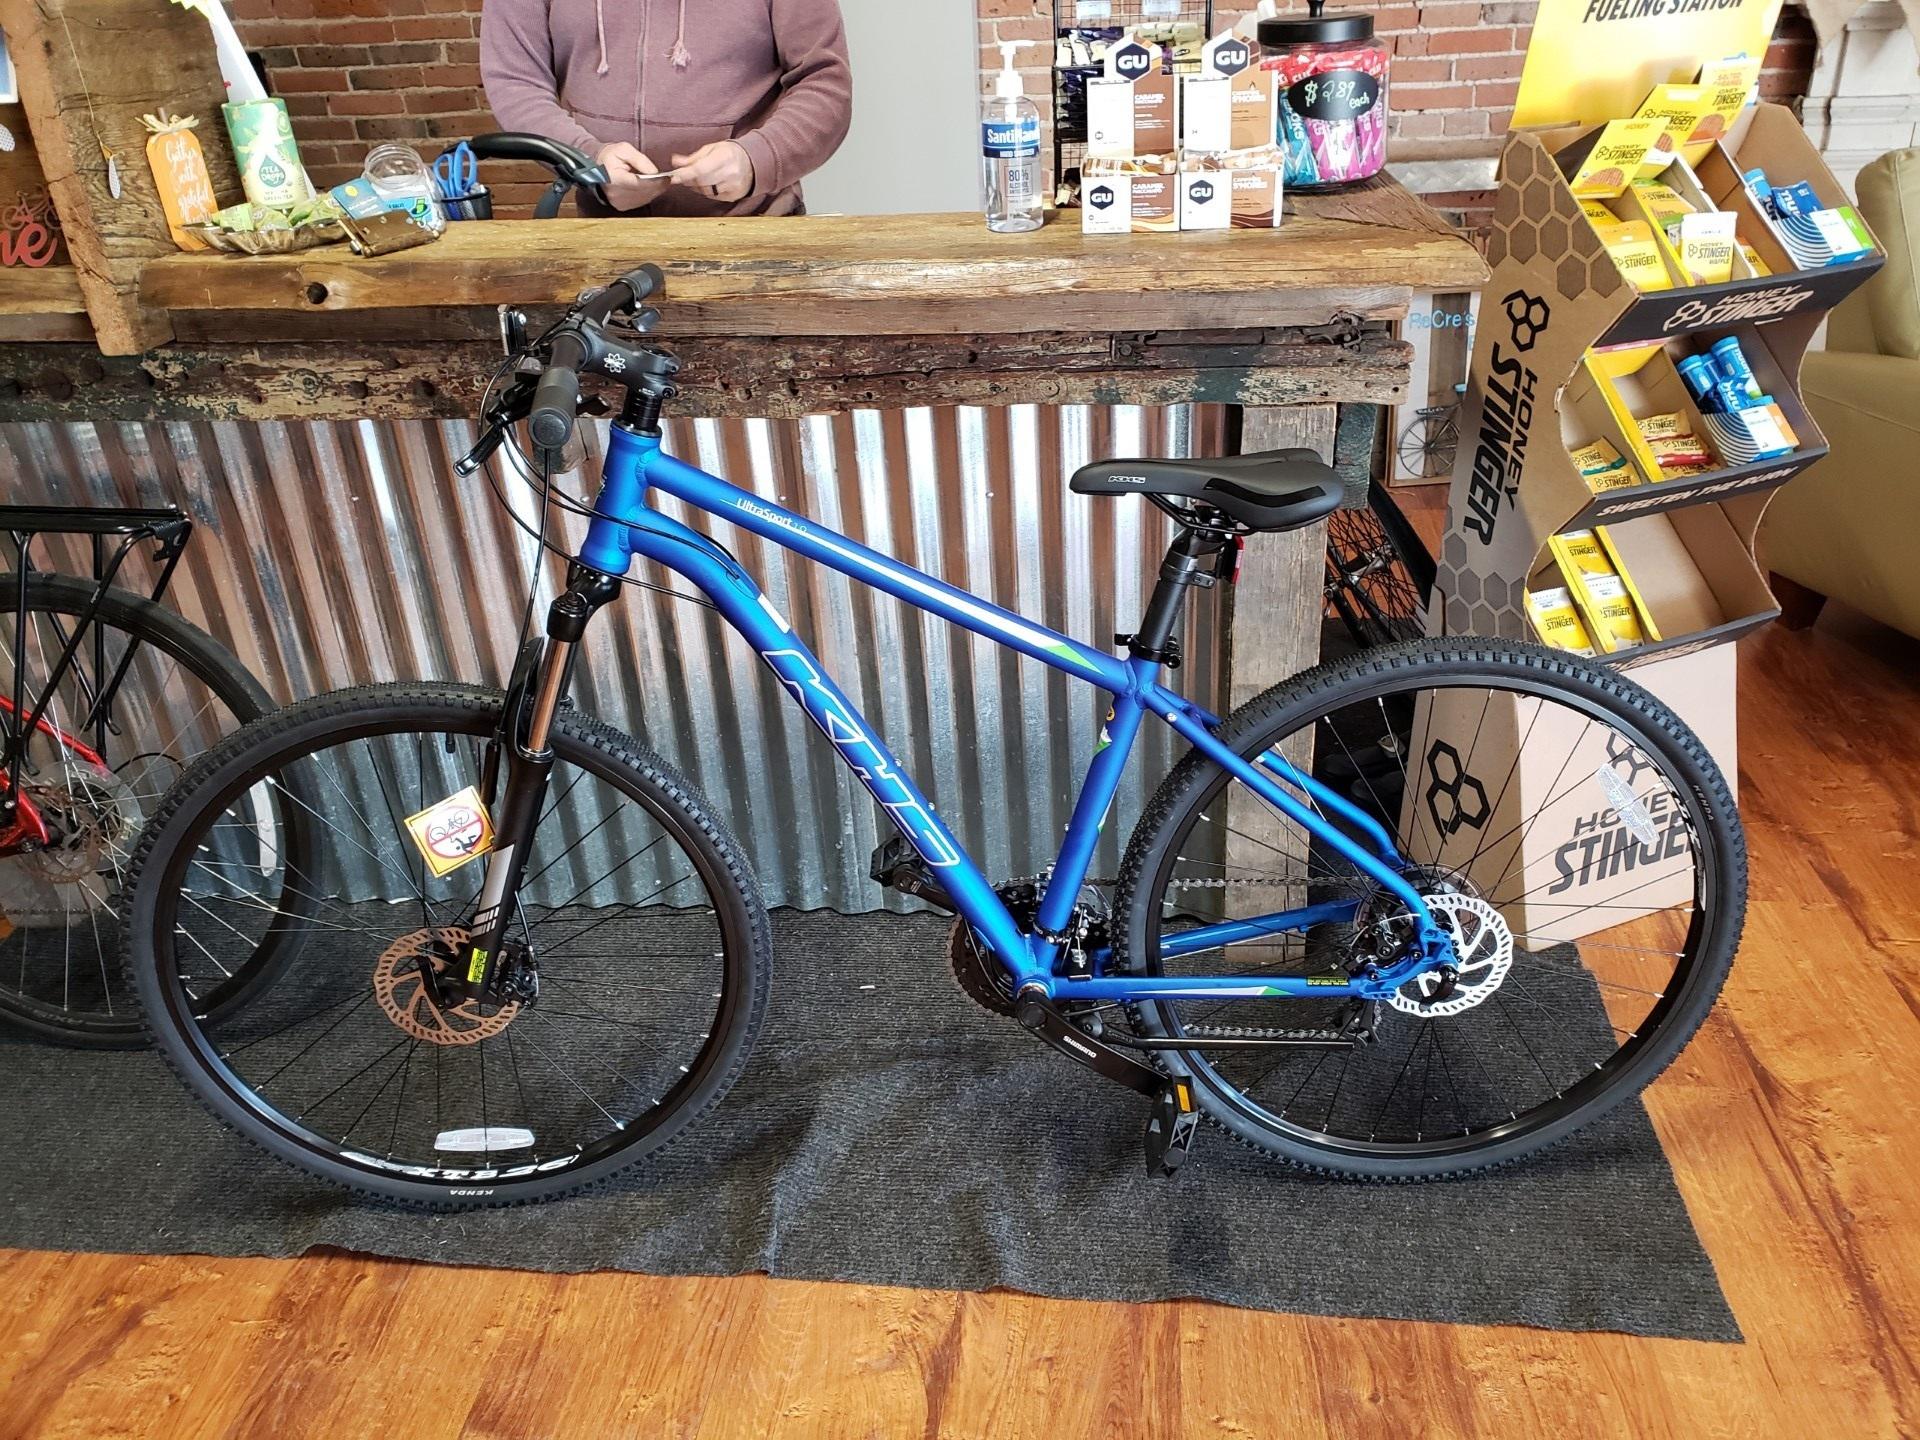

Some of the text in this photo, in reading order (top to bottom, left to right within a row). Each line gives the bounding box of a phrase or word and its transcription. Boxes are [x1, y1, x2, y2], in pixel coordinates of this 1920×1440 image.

[1117, 55, 1148, 69] GU
[1215, 50, 1246, 65] GU
[1712, 92, 1746, 106] TINGER
[1604, 148, 1648, 160] STINGER
[1091, 193, 1112, 203] GU
[1190, 187, 1212, 198] GU
[1698, 247, 1730, 259] STINGER
[1624, 255, 1658, 269] STINGER
[1717, 284, 1803, 306] HONEY
[1686, 290, 1814, 328] STINGER
[1464, 342, 1522, 546] STINGER
[1504, 367, 1538, 512] HONEY
[1108, 475, 1146, 484] KHS
[1596, 489, 1699, 516] SWEETEN
[736, 497, 793, 525] UltraSport
[1569, 547, 1598, 556] STINGER
[1603, 607, 1631, 618] STINGER
[1546, 618, 1576, 630] STINGER
[762, 649, 960, 866] KHS
[1693, 785, 1714, 821] KENDA
[1574, 791, 1669, 837] HOE
[1549, 810, 1692, 895] STINGE
[1063, 1035, 1097, 1059] SHIMANO
